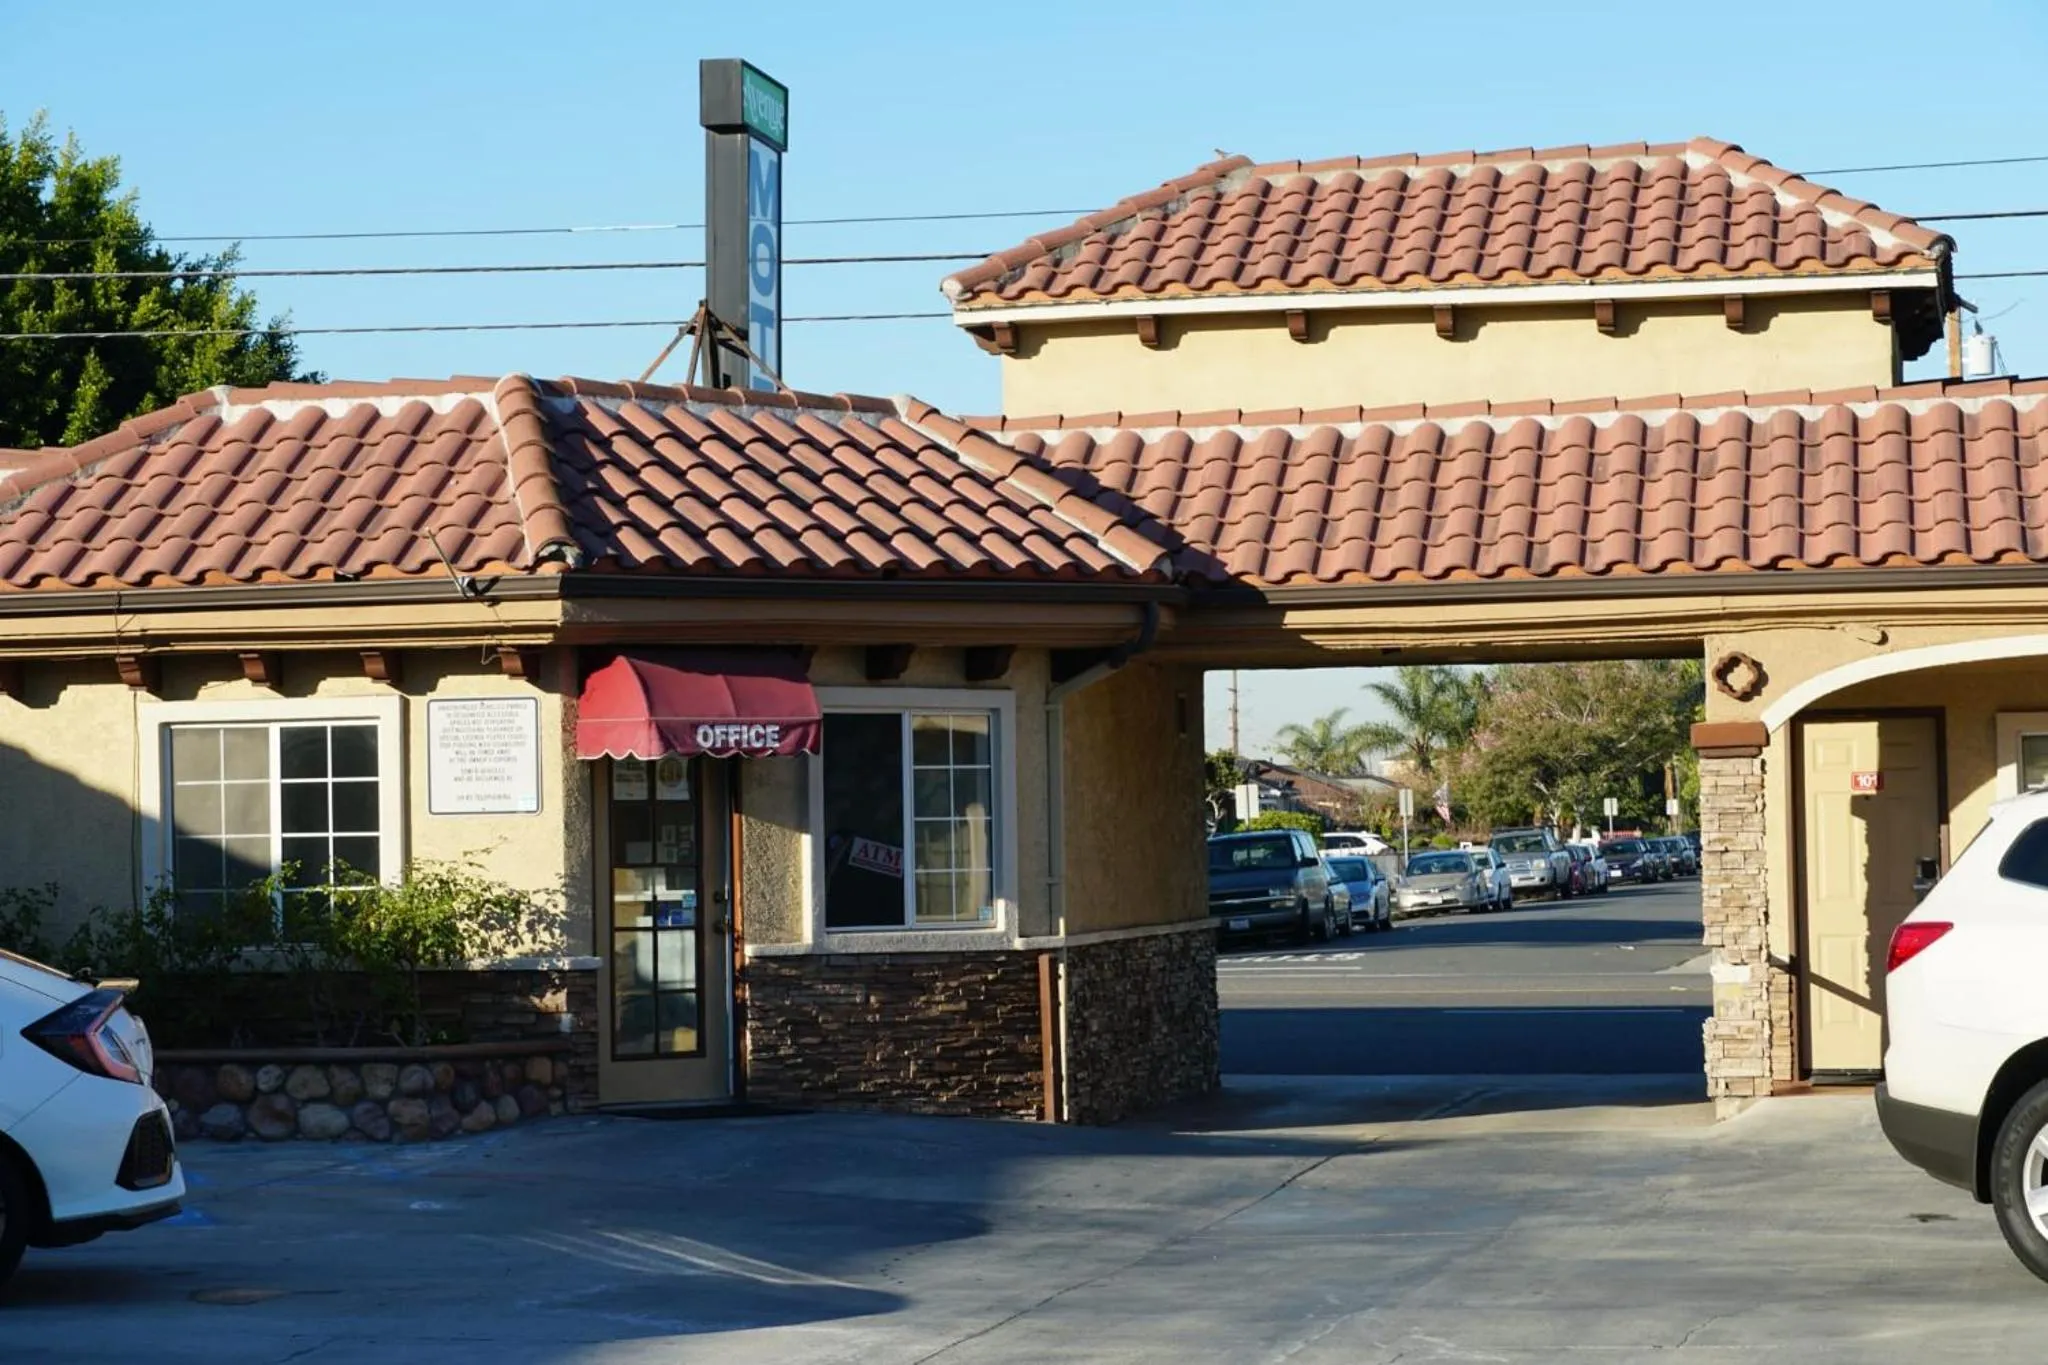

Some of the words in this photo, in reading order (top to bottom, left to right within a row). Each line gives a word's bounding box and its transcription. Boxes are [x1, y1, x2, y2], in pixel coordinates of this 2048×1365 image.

[750, 149, 777, 391] MOT
[696, 724, 780, 748] OFFICE
[1855, 774, 1878, 788] 101
[855, 842, 901, 868] ATM
